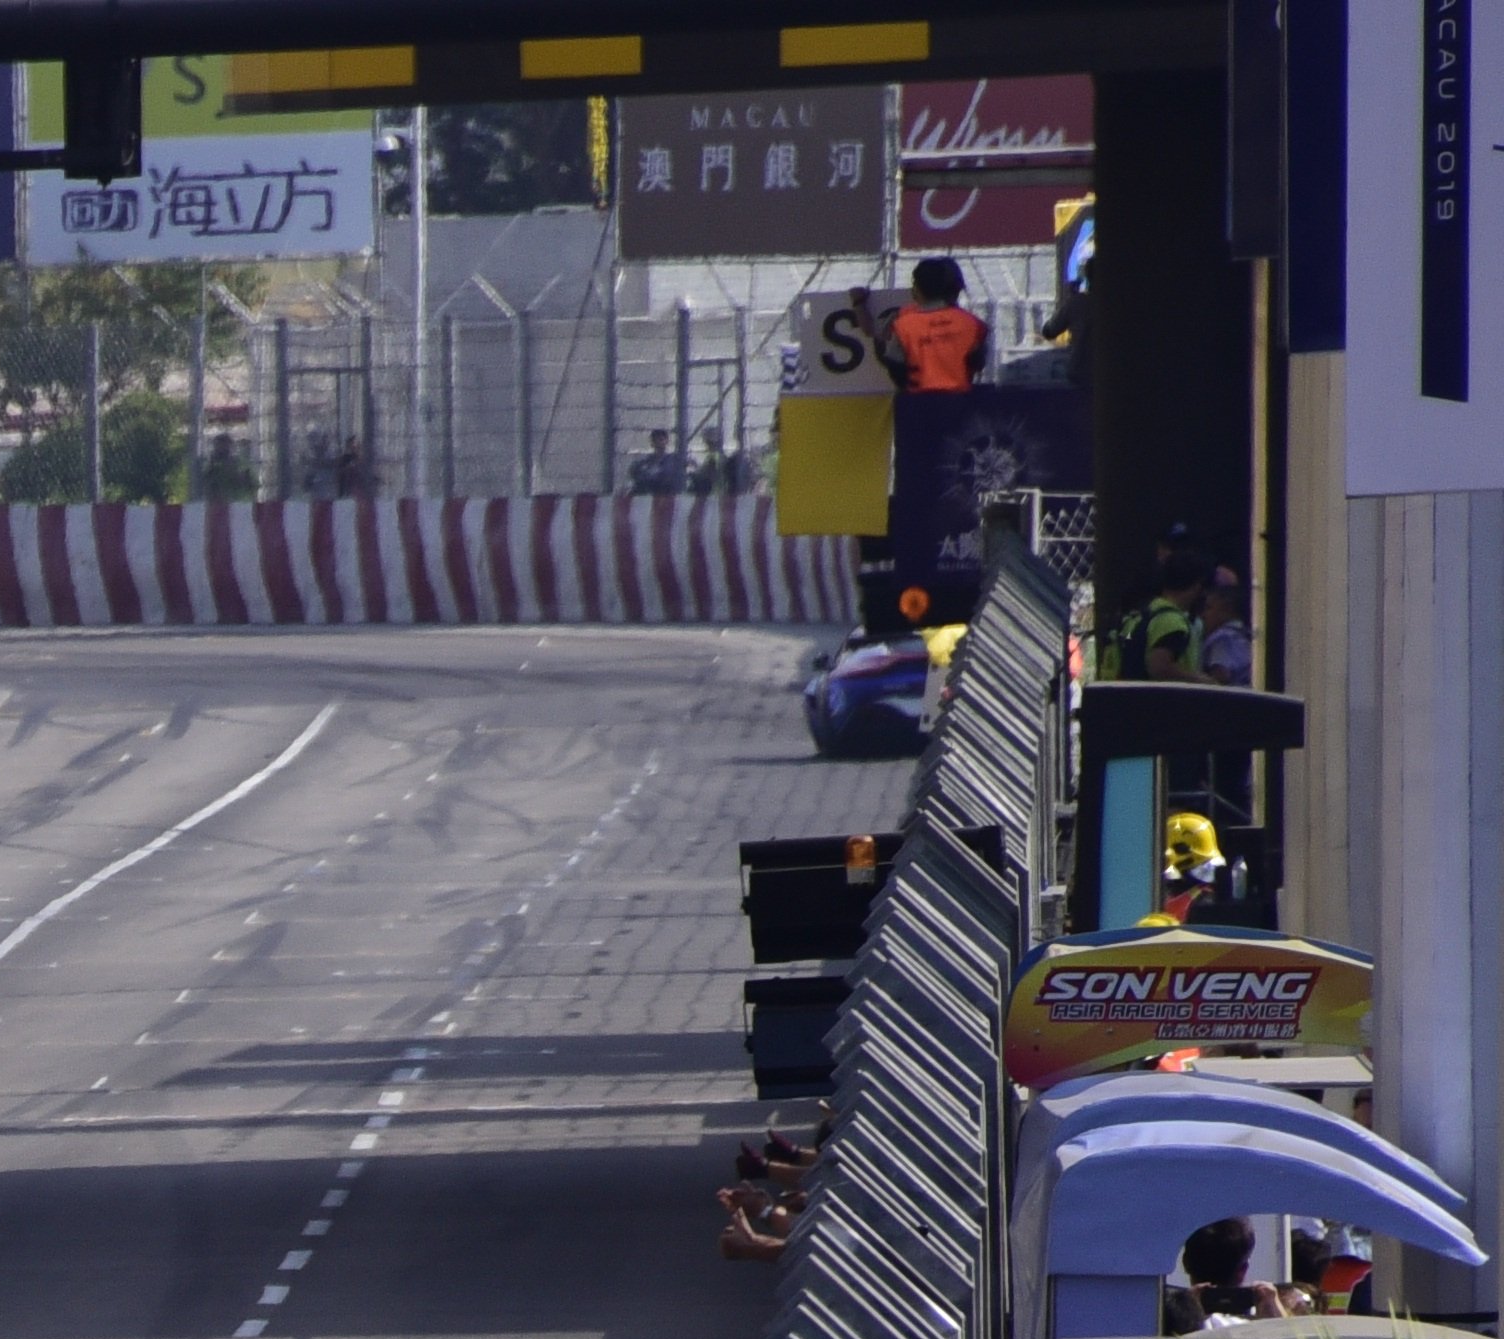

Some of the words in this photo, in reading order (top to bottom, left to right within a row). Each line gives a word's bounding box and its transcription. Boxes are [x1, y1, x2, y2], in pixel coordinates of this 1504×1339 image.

[637, 141, 865, 192] 澳門銀河
[1438, 122, 1457, 221] 2019
[1043, 971, 1158, 1001] SON
[1172, 971, 1313, 1001] VENG
[1051, 1002, 1106, 1020] ASIA
[1108, 1002, 1192, 1020] RACING
[1197, 1002, 1298, 1020] SERVICE
